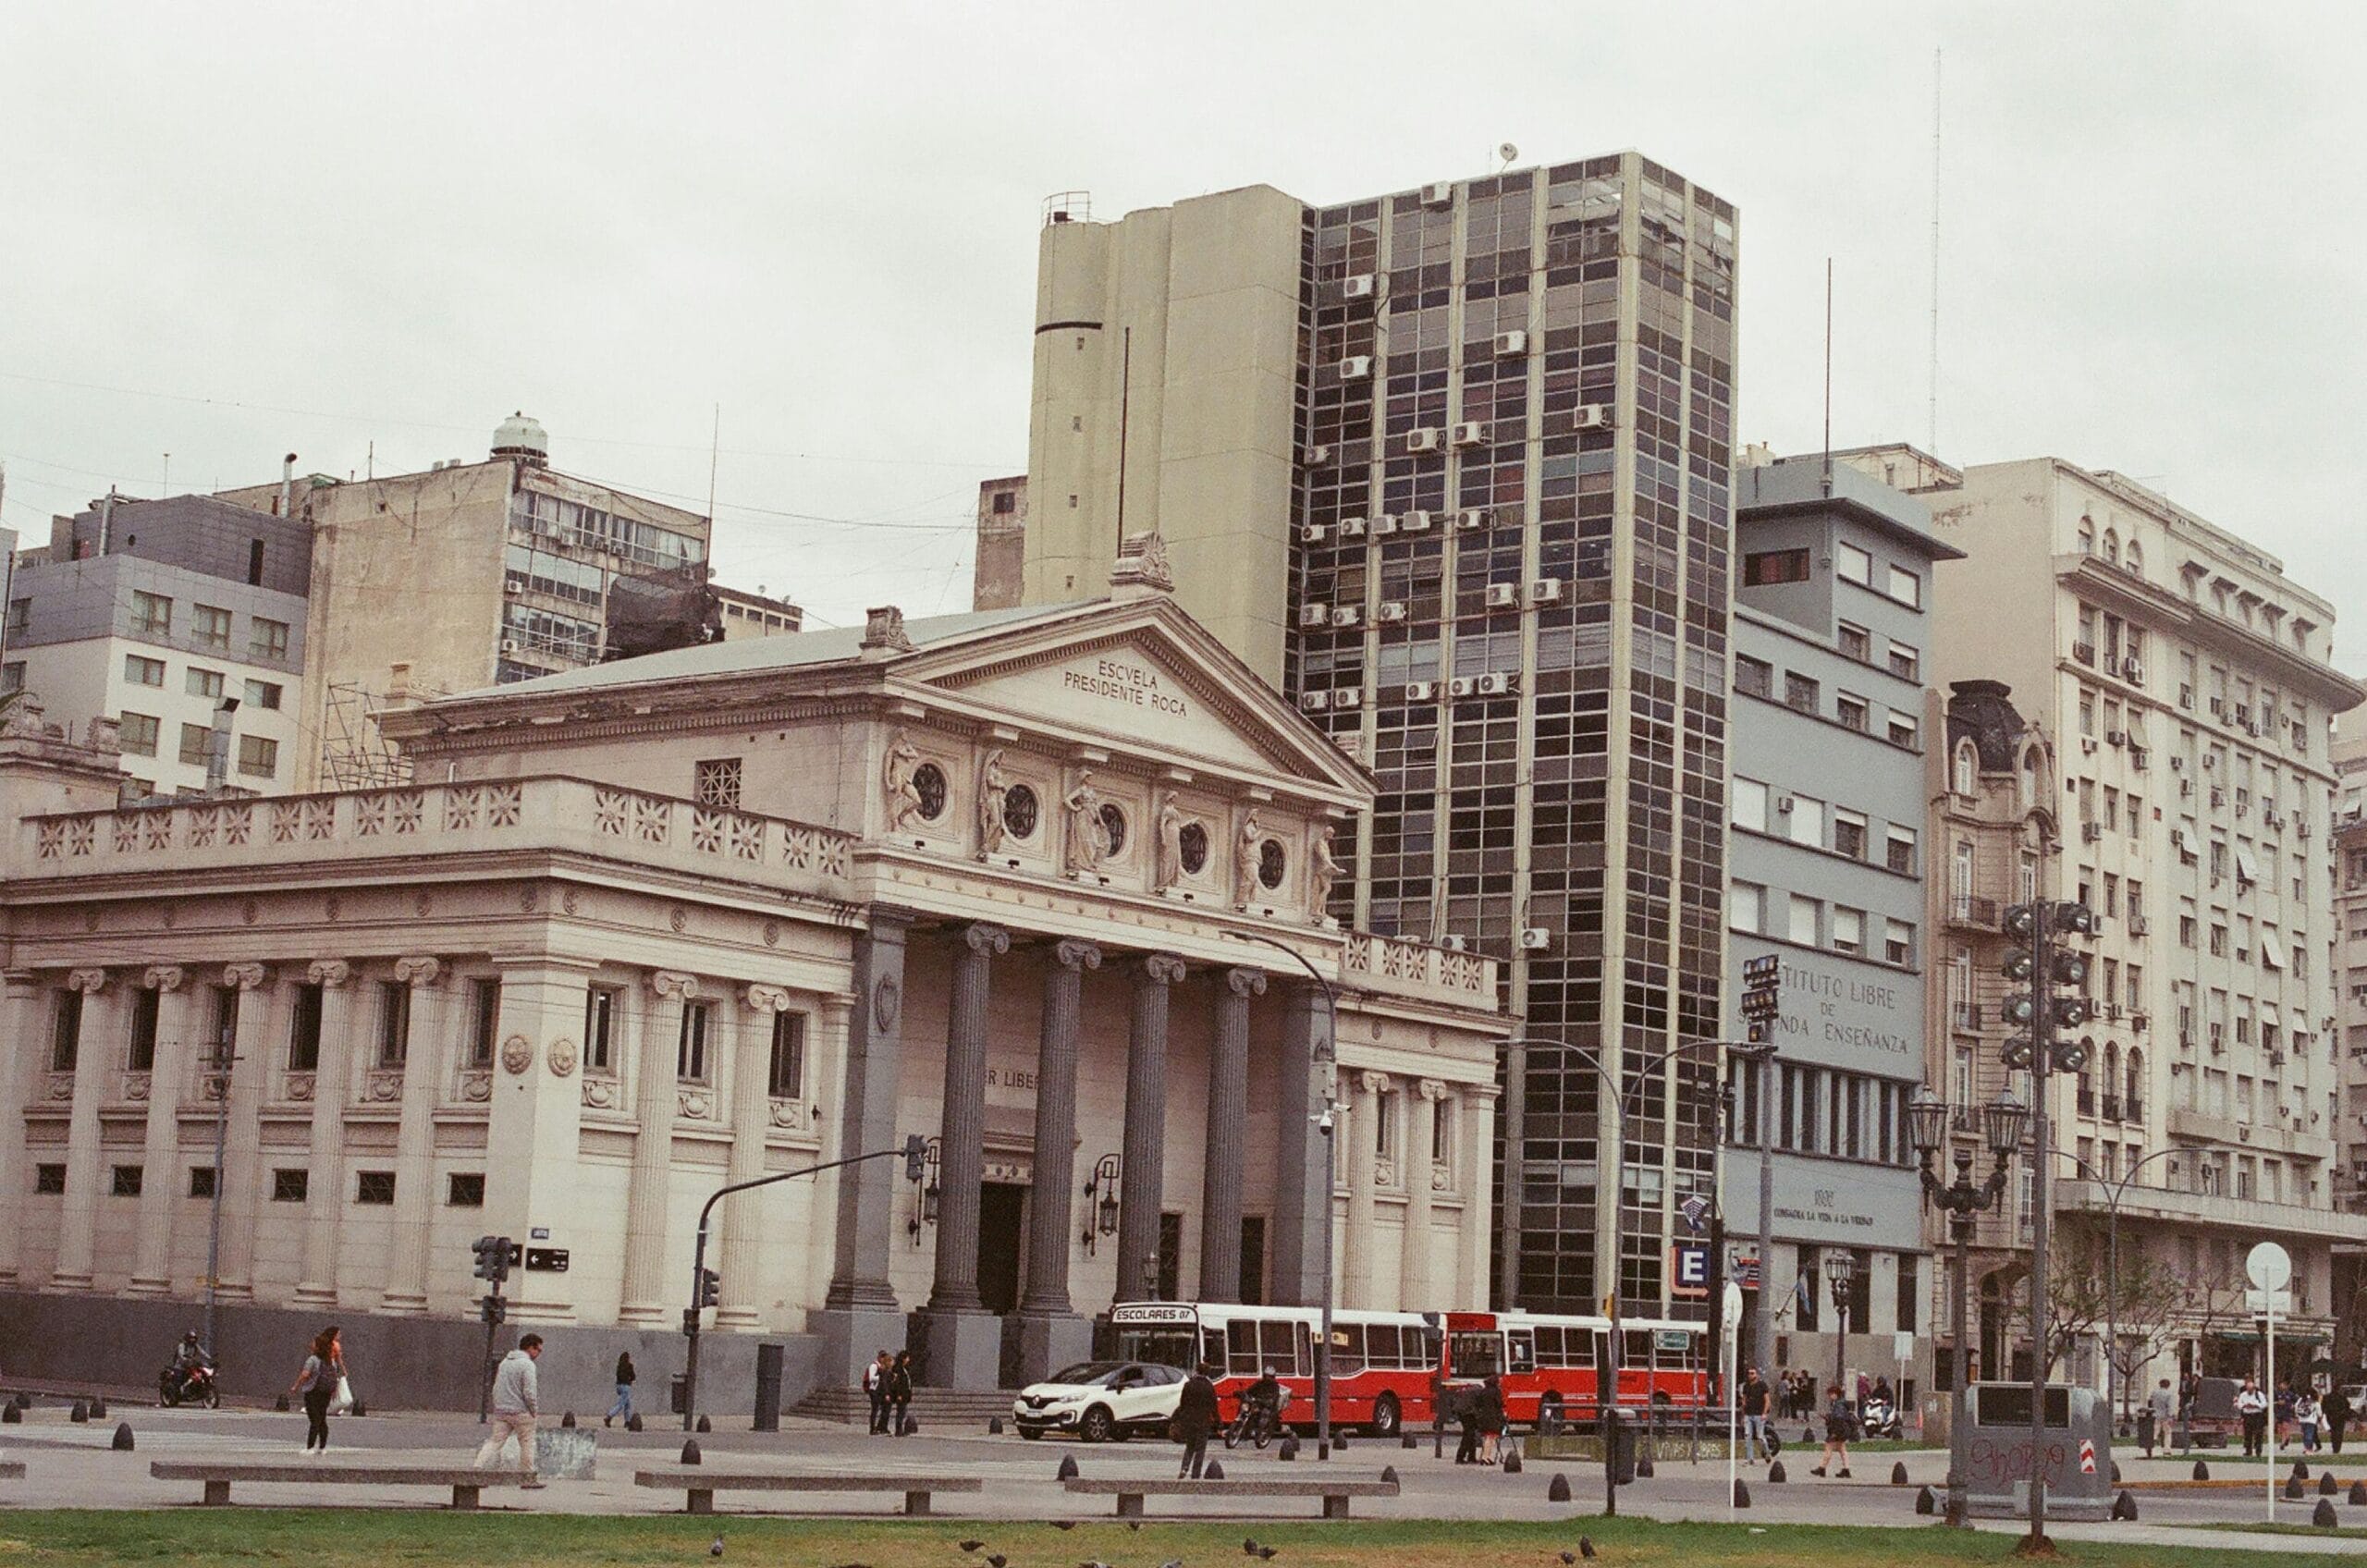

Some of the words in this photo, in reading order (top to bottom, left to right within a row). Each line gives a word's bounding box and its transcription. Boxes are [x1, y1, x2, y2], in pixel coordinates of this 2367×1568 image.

[1098, 660, 1158, 690] ESCVELA
[1064, 671, 1144, 704] PRESIDENTE
[1151, 693, 1187, 717] ROCA
[1780, 965, 1844, 998] TITUTO
[1850, 981, 1895, 1010] LIBRE
[1821, 1001, 1835, 1018] DE
[1825, 1023, 1908, 1055] ENSEÑANZA
[1684, 1251, 1703, 1281] E
[1116, 1309, 1176, 1320] ESCOLARES
